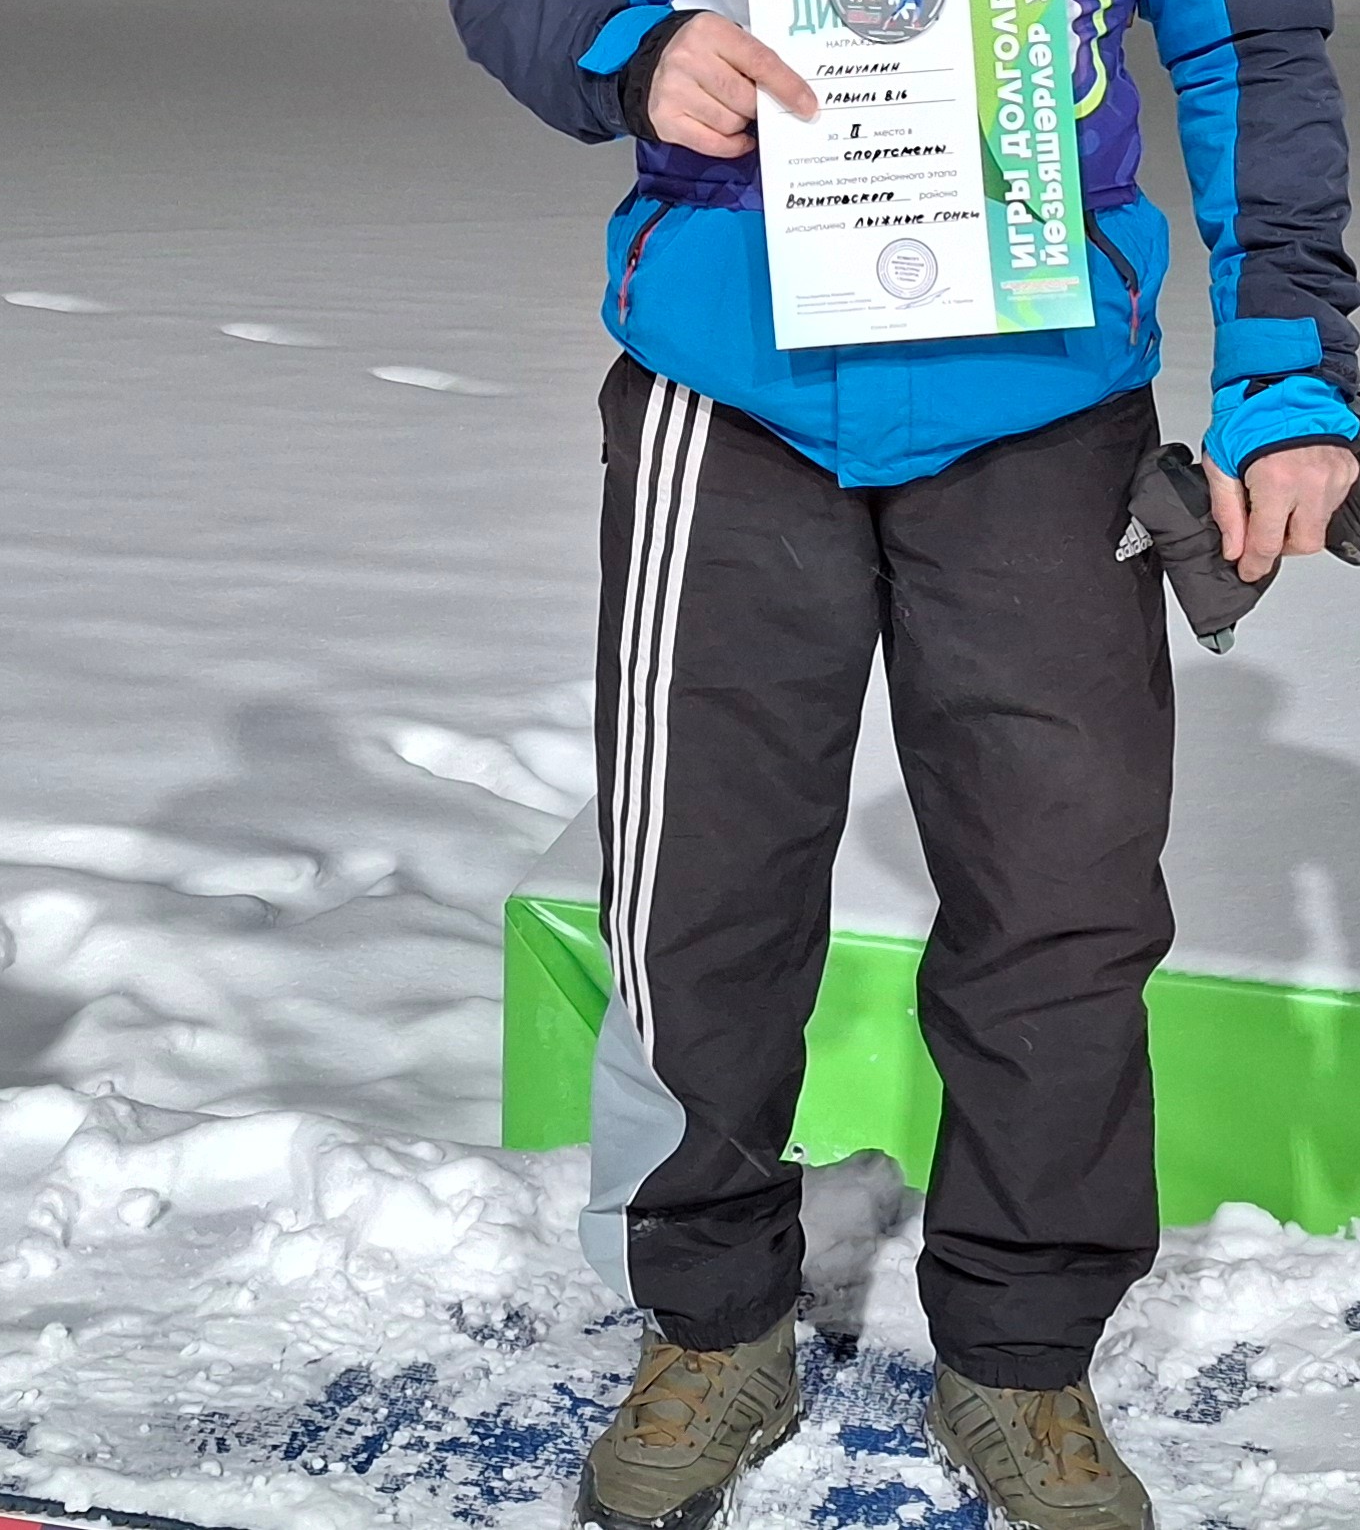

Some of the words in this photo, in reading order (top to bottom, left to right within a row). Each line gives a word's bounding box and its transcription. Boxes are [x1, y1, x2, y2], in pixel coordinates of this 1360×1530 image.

[873, 129, 906, 137] место
[870, 172, 925, 184] районного
[927, 169, 957, 178] этапа
[919, 189, 958, 201] района
[1003, 169, 1037, 268] ИГРЫ
